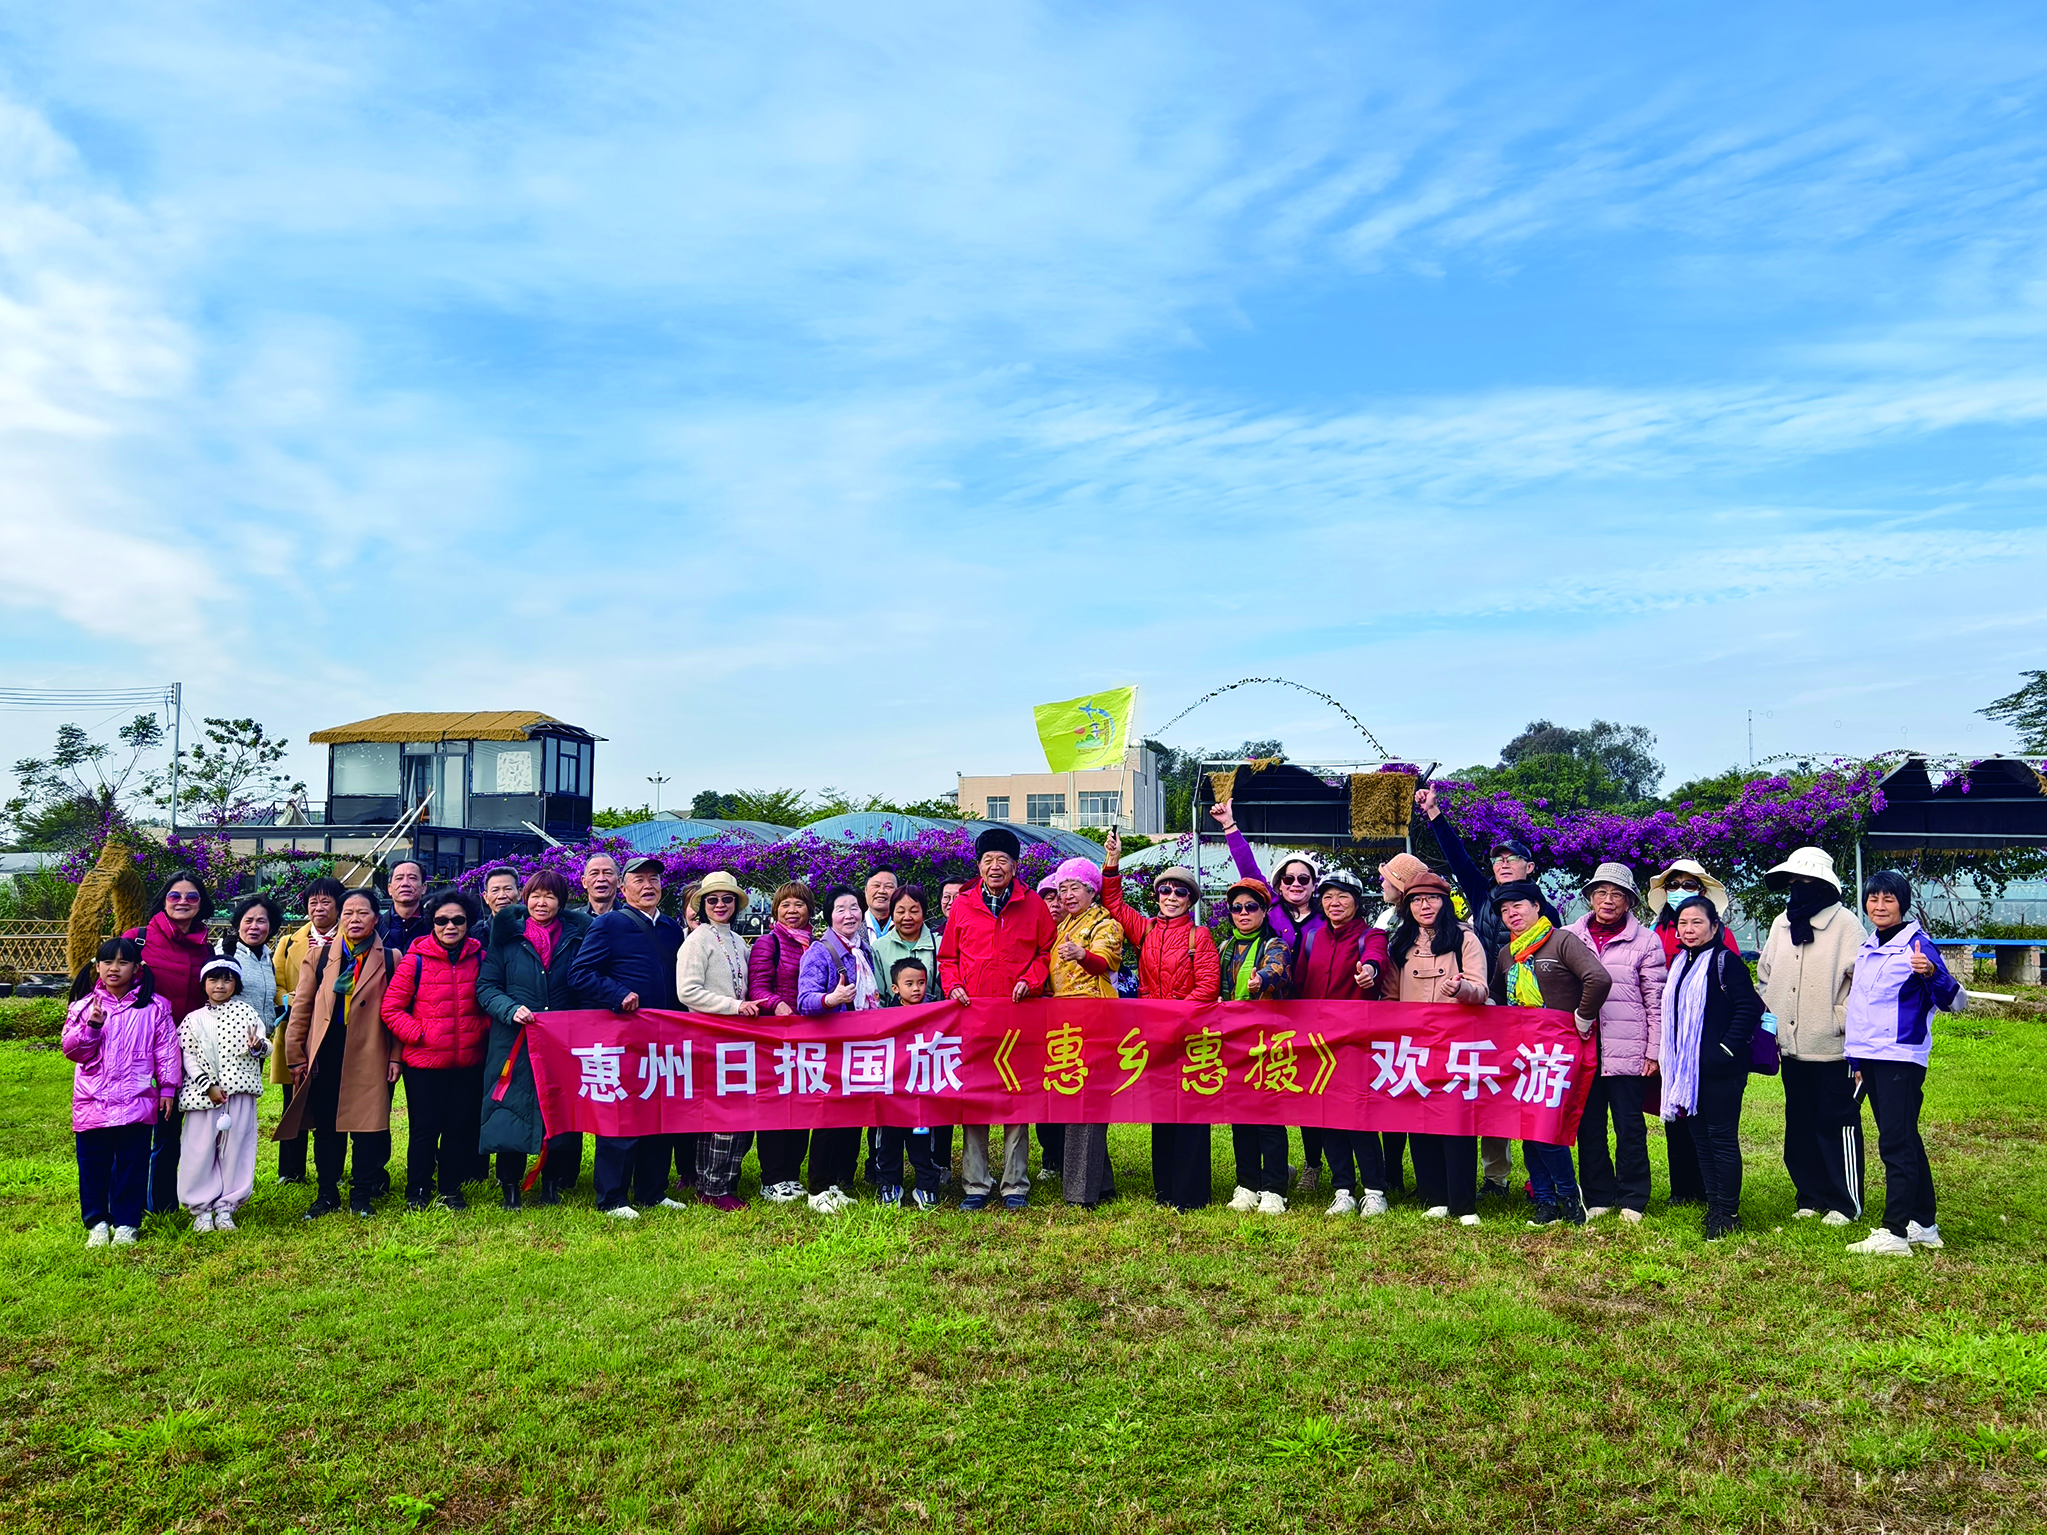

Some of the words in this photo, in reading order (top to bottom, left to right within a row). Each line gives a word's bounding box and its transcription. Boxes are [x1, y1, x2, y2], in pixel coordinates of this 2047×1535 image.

[570, 1022, 1575, 1108] 惠州日报国旅《惠乡惠摄》欢乐游
